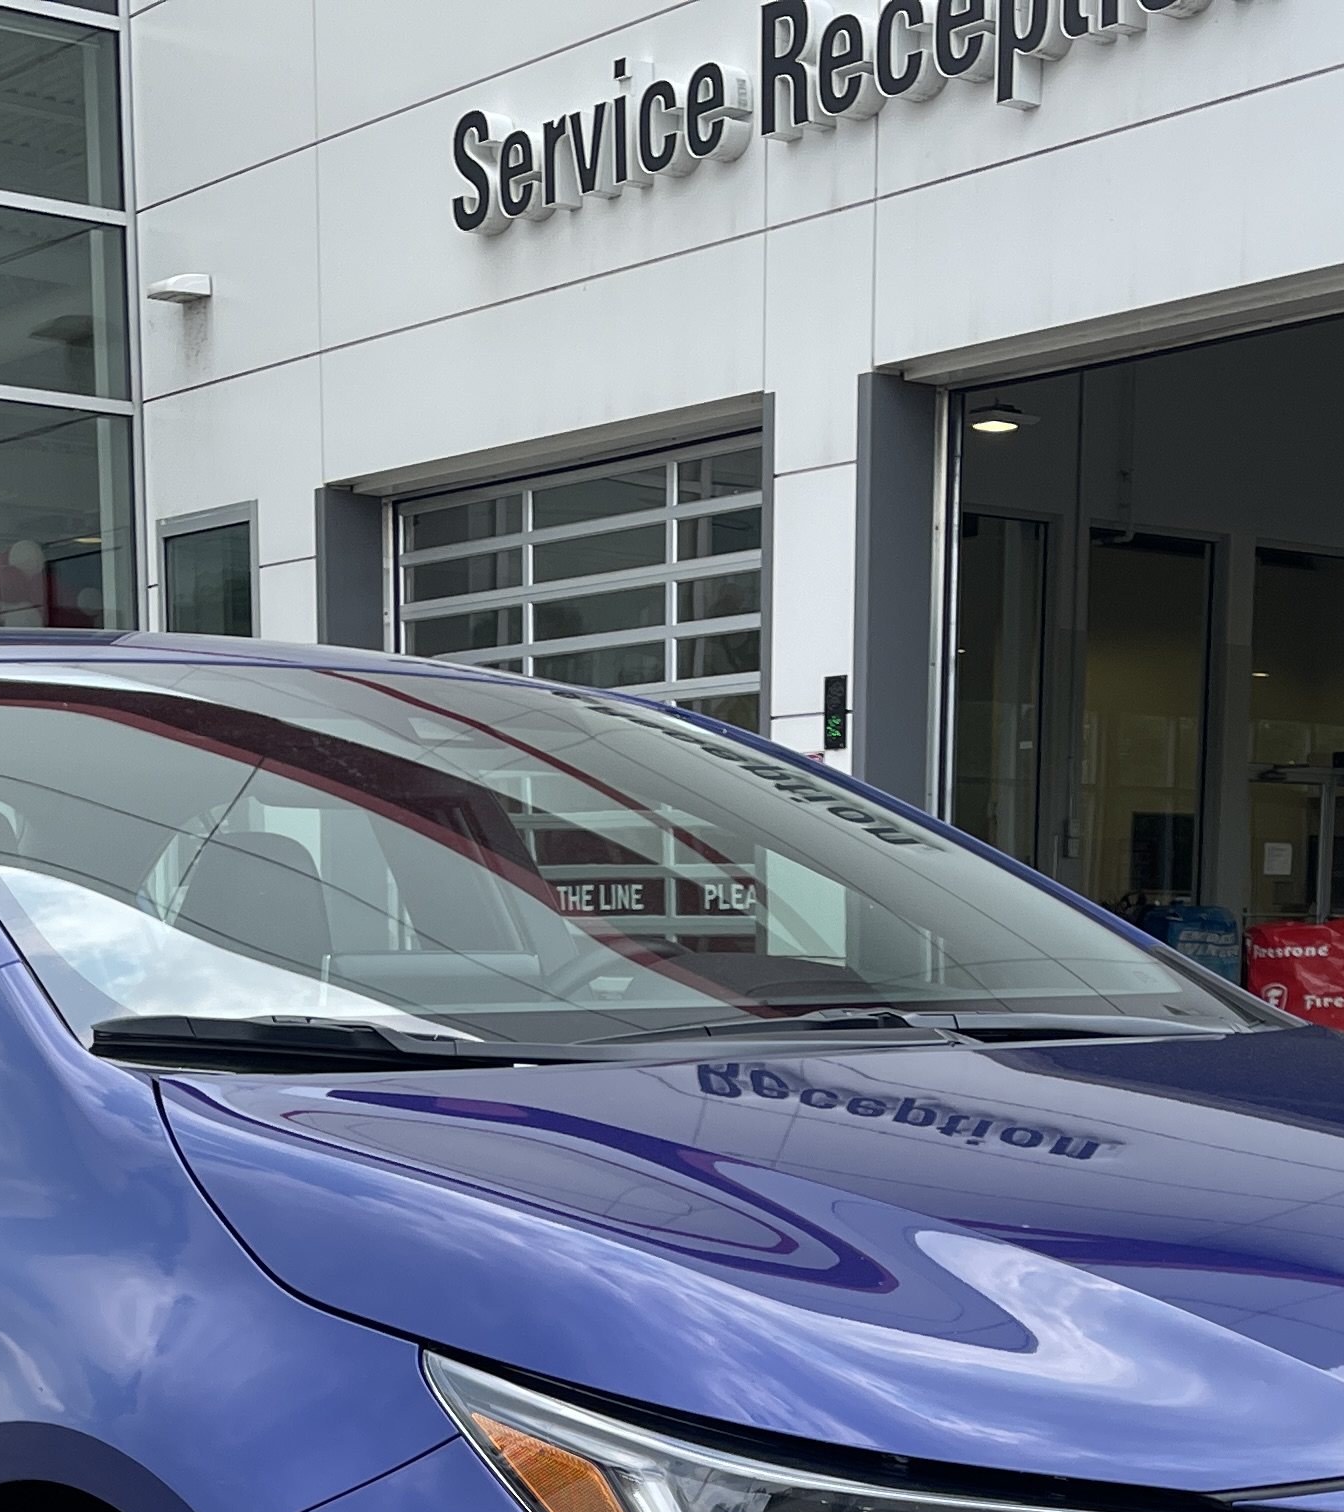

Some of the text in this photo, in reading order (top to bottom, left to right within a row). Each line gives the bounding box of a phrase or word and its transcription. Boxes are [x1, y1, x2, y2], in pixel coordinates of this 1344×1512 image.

[452, 57, 728, 233] Service
[557, 884, 644, 911] THE LINE
